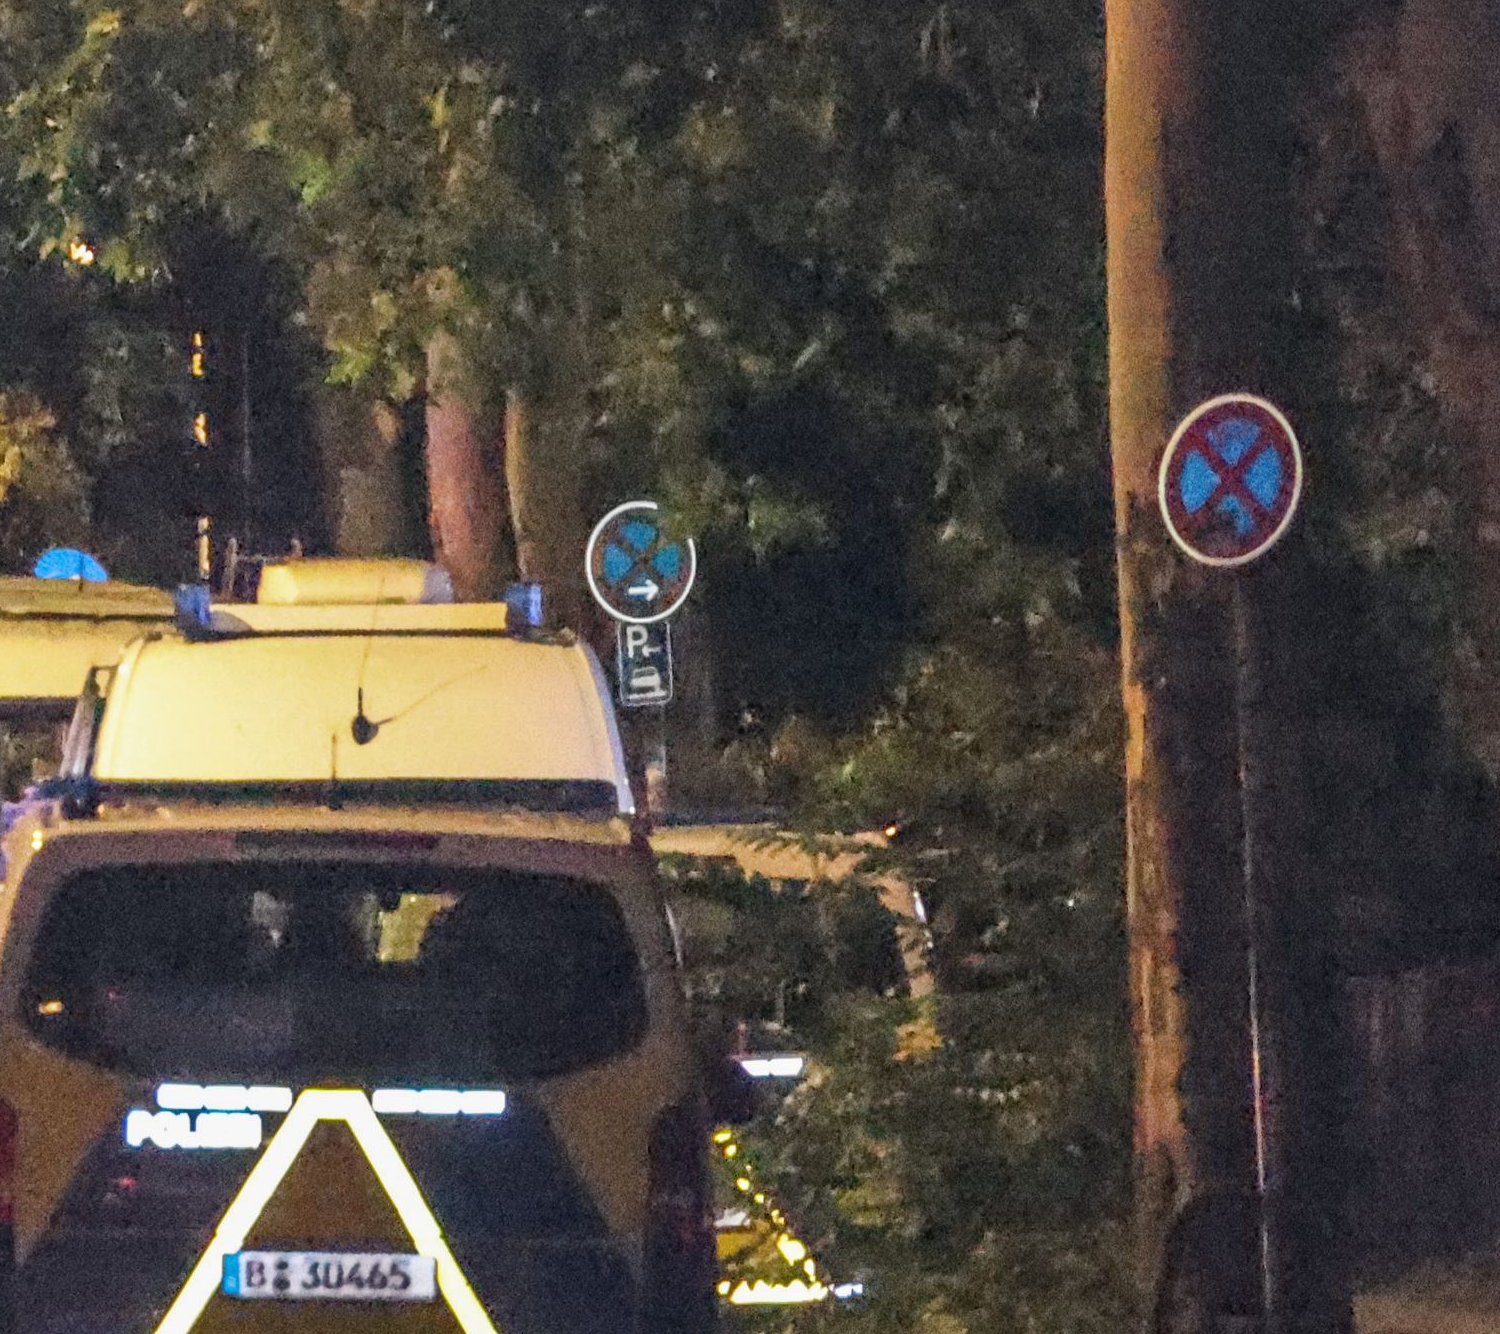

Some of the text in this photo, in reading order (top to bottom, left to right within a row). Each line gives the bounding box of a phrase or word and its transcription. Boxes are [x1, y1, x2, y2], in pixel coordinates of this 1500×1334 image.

[626, 625, 649, 659] P
[245, 1260, 411, 1290] B 30465
